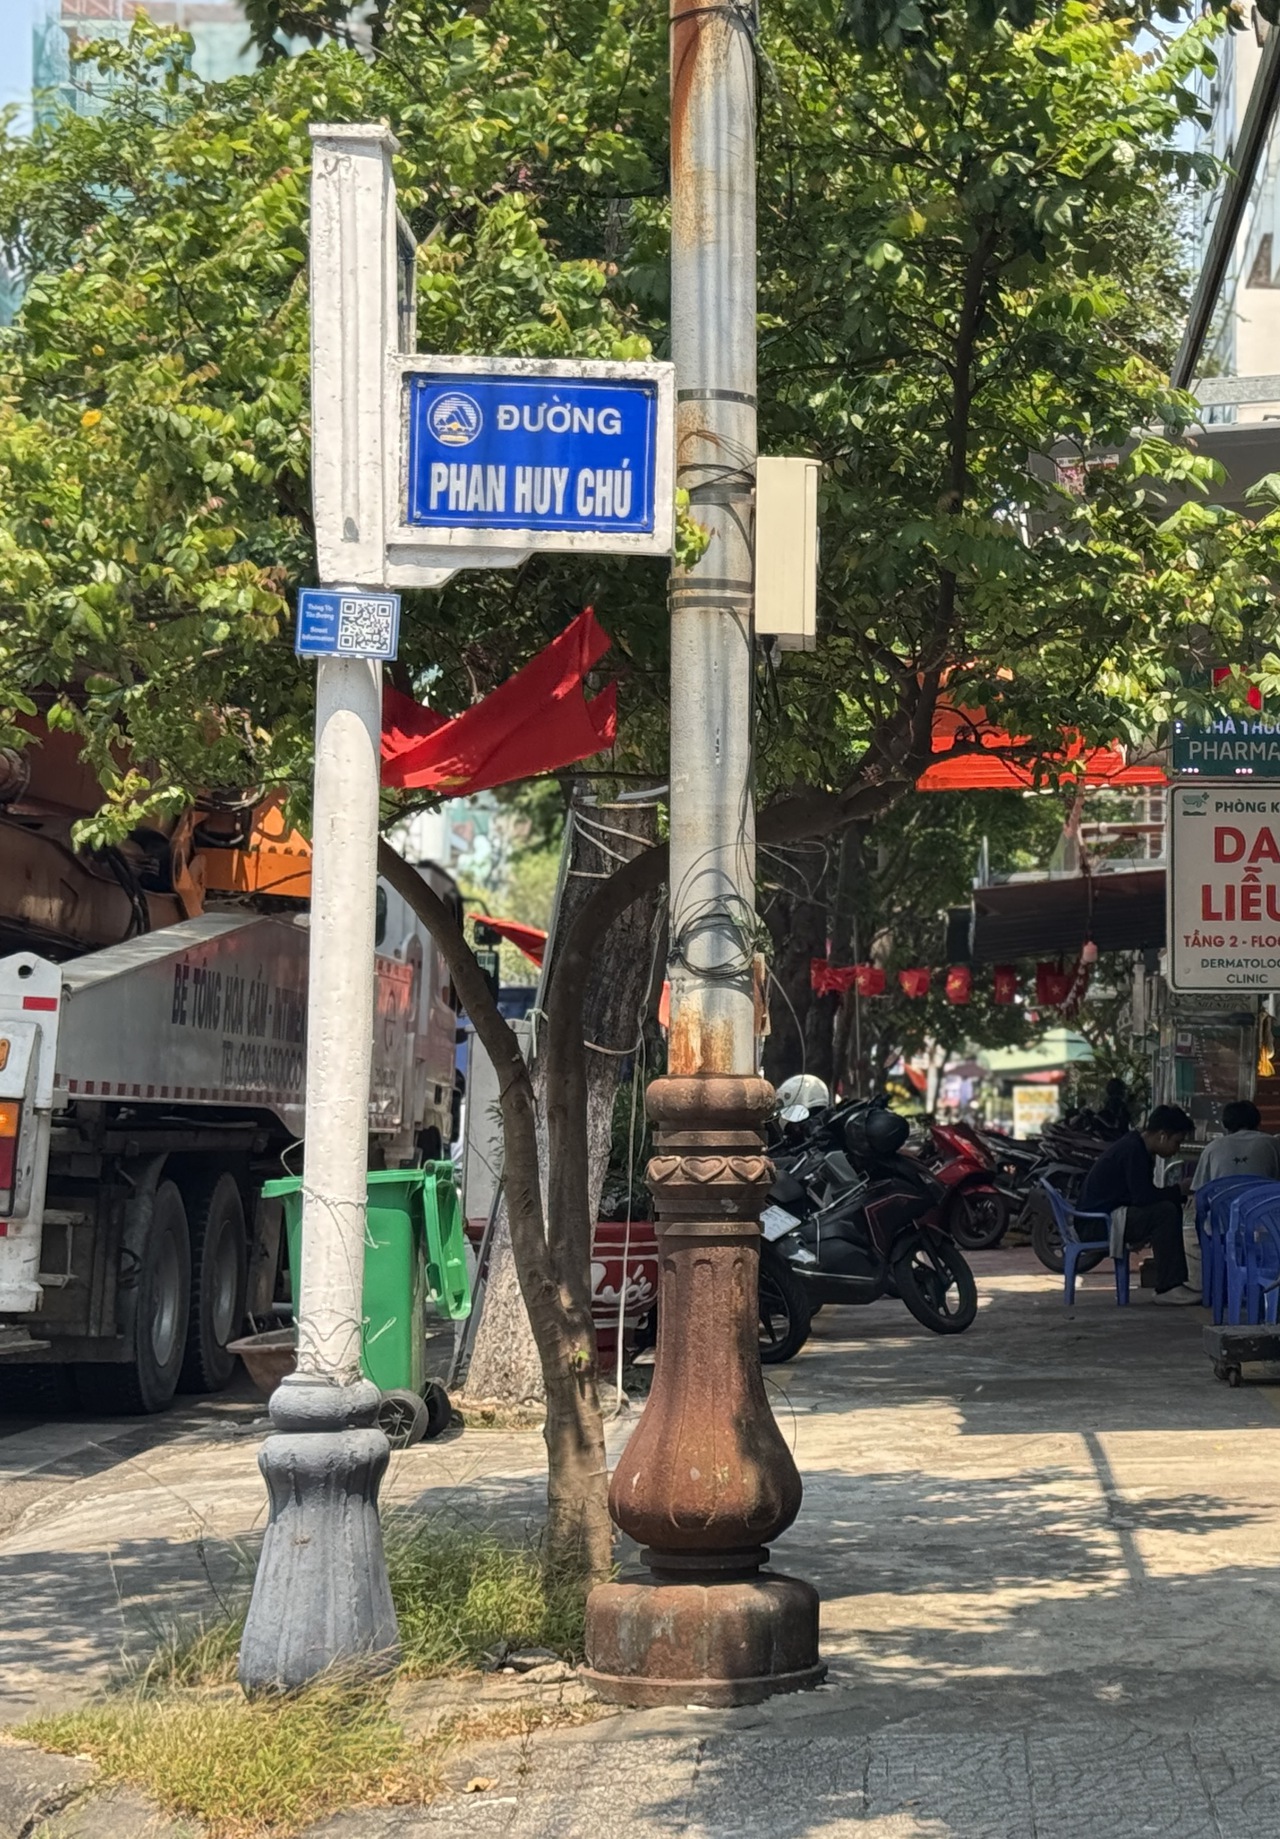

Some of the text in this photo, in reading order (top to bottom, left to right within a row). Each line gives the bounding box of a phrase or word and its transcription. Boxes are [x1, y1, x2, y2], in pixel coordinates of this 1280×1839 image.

[497, 395, 622, 435] ĐƯỜNG
[429, 458, 632, 518] PHAN HUY CHÚ
[1215, 799, 1266, 813] PHÒNG
[1229, 935, 1238, 948] 2
[1226, 974, 1269, 984] CLINIC
